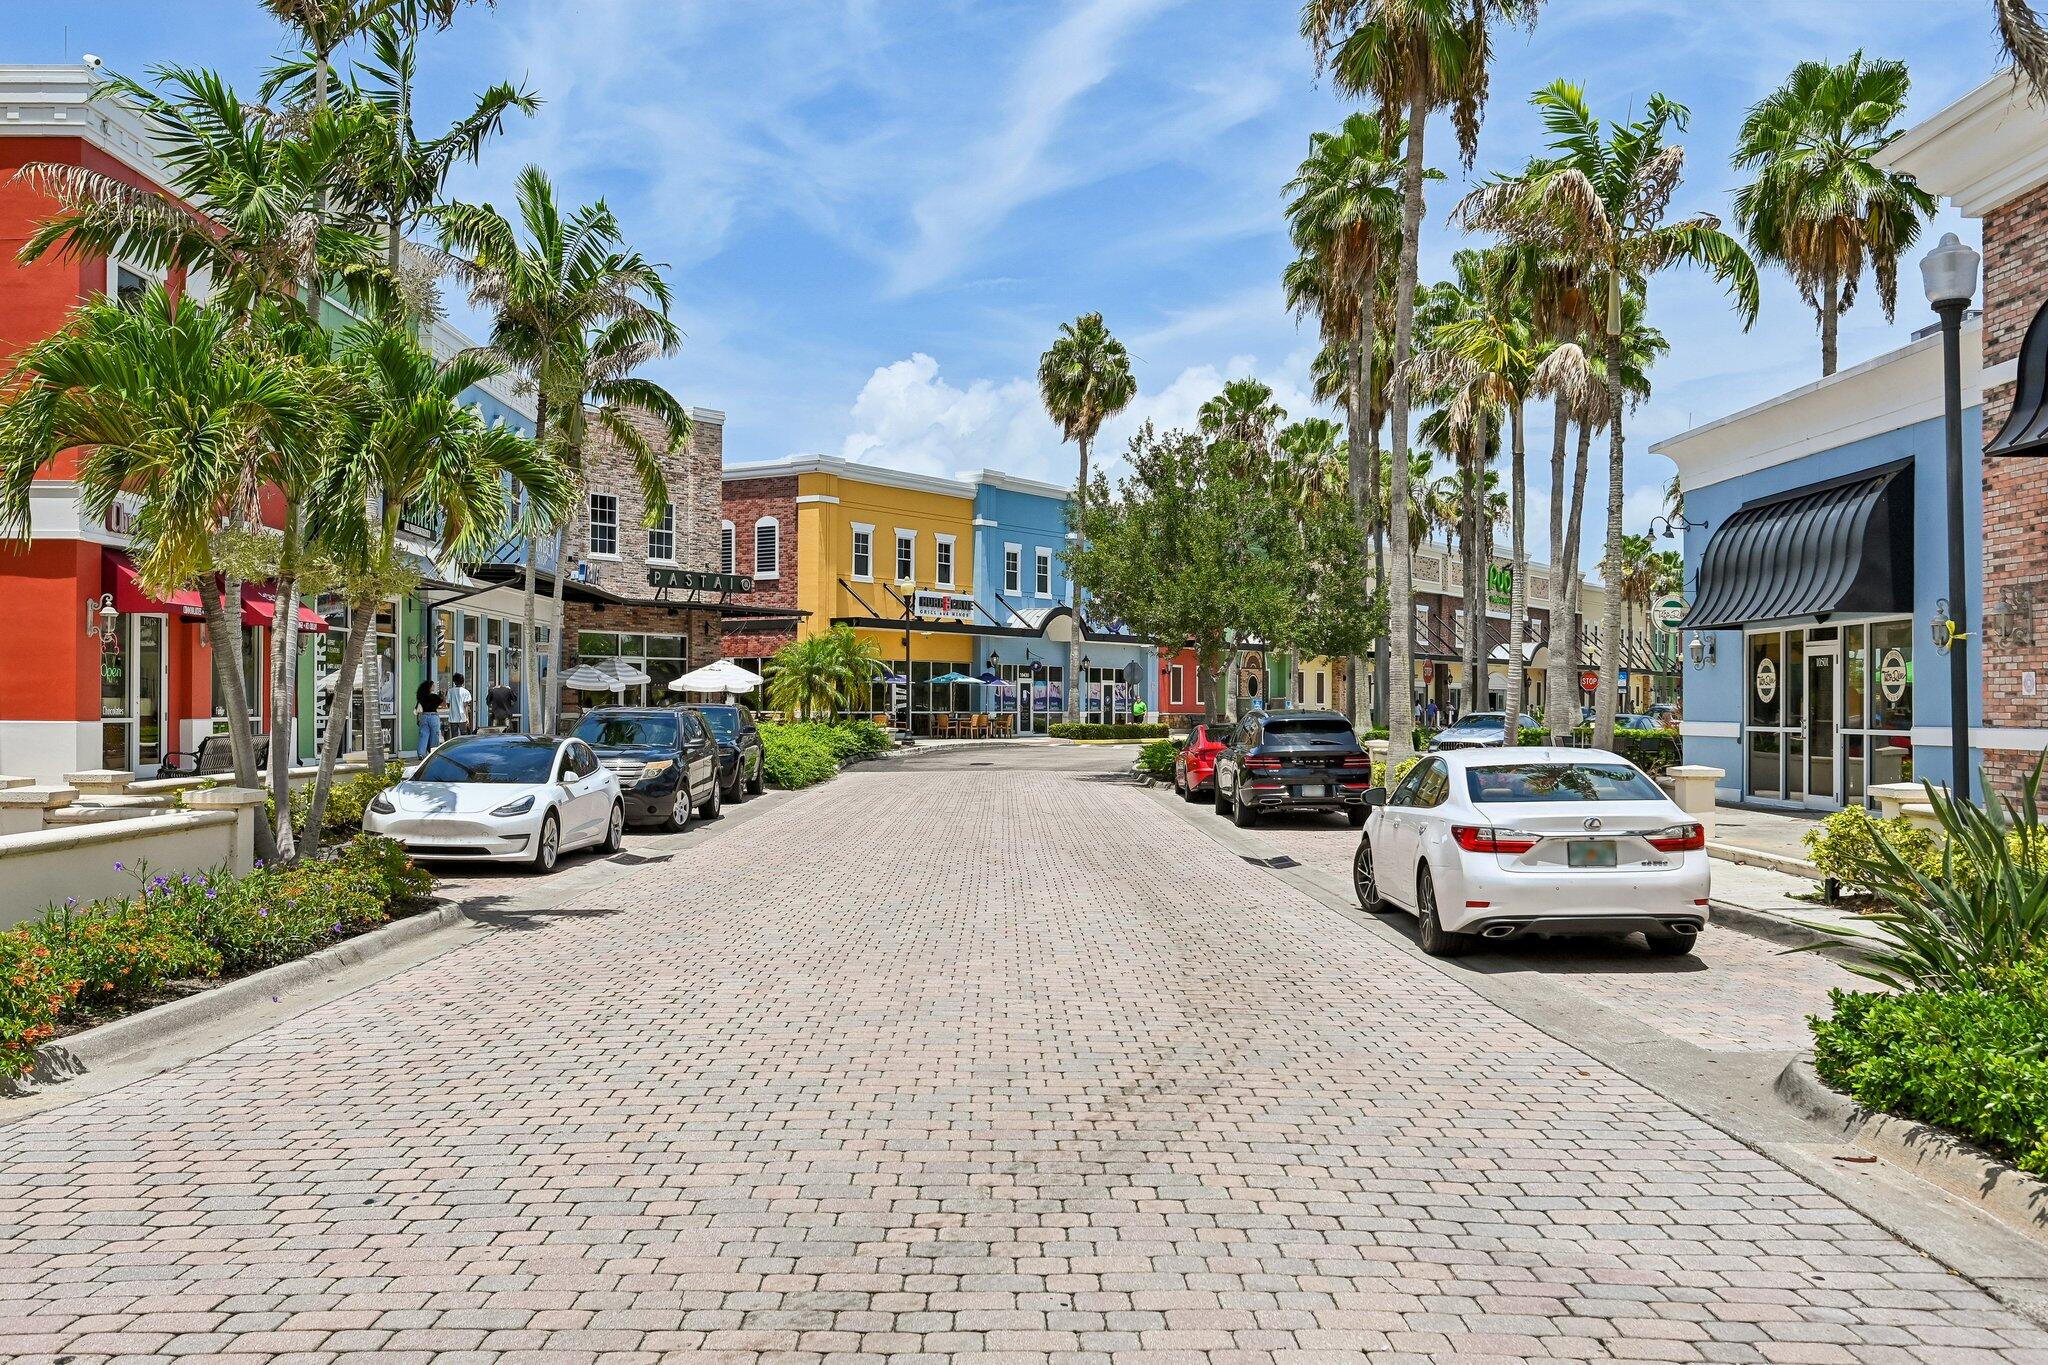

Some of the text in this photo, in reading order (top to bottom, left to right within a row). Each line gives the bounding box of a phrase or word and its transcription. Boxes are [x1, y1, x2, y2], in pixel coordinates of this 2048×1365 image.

[654, 571, 751, 591] PASTAIO
[1487, 563, 1513, 594] Pub
[100, 663, 122, 681] Open
[1582, 677, 1598, 685] STOP
[102, 706, 124, 715] Chocolates
